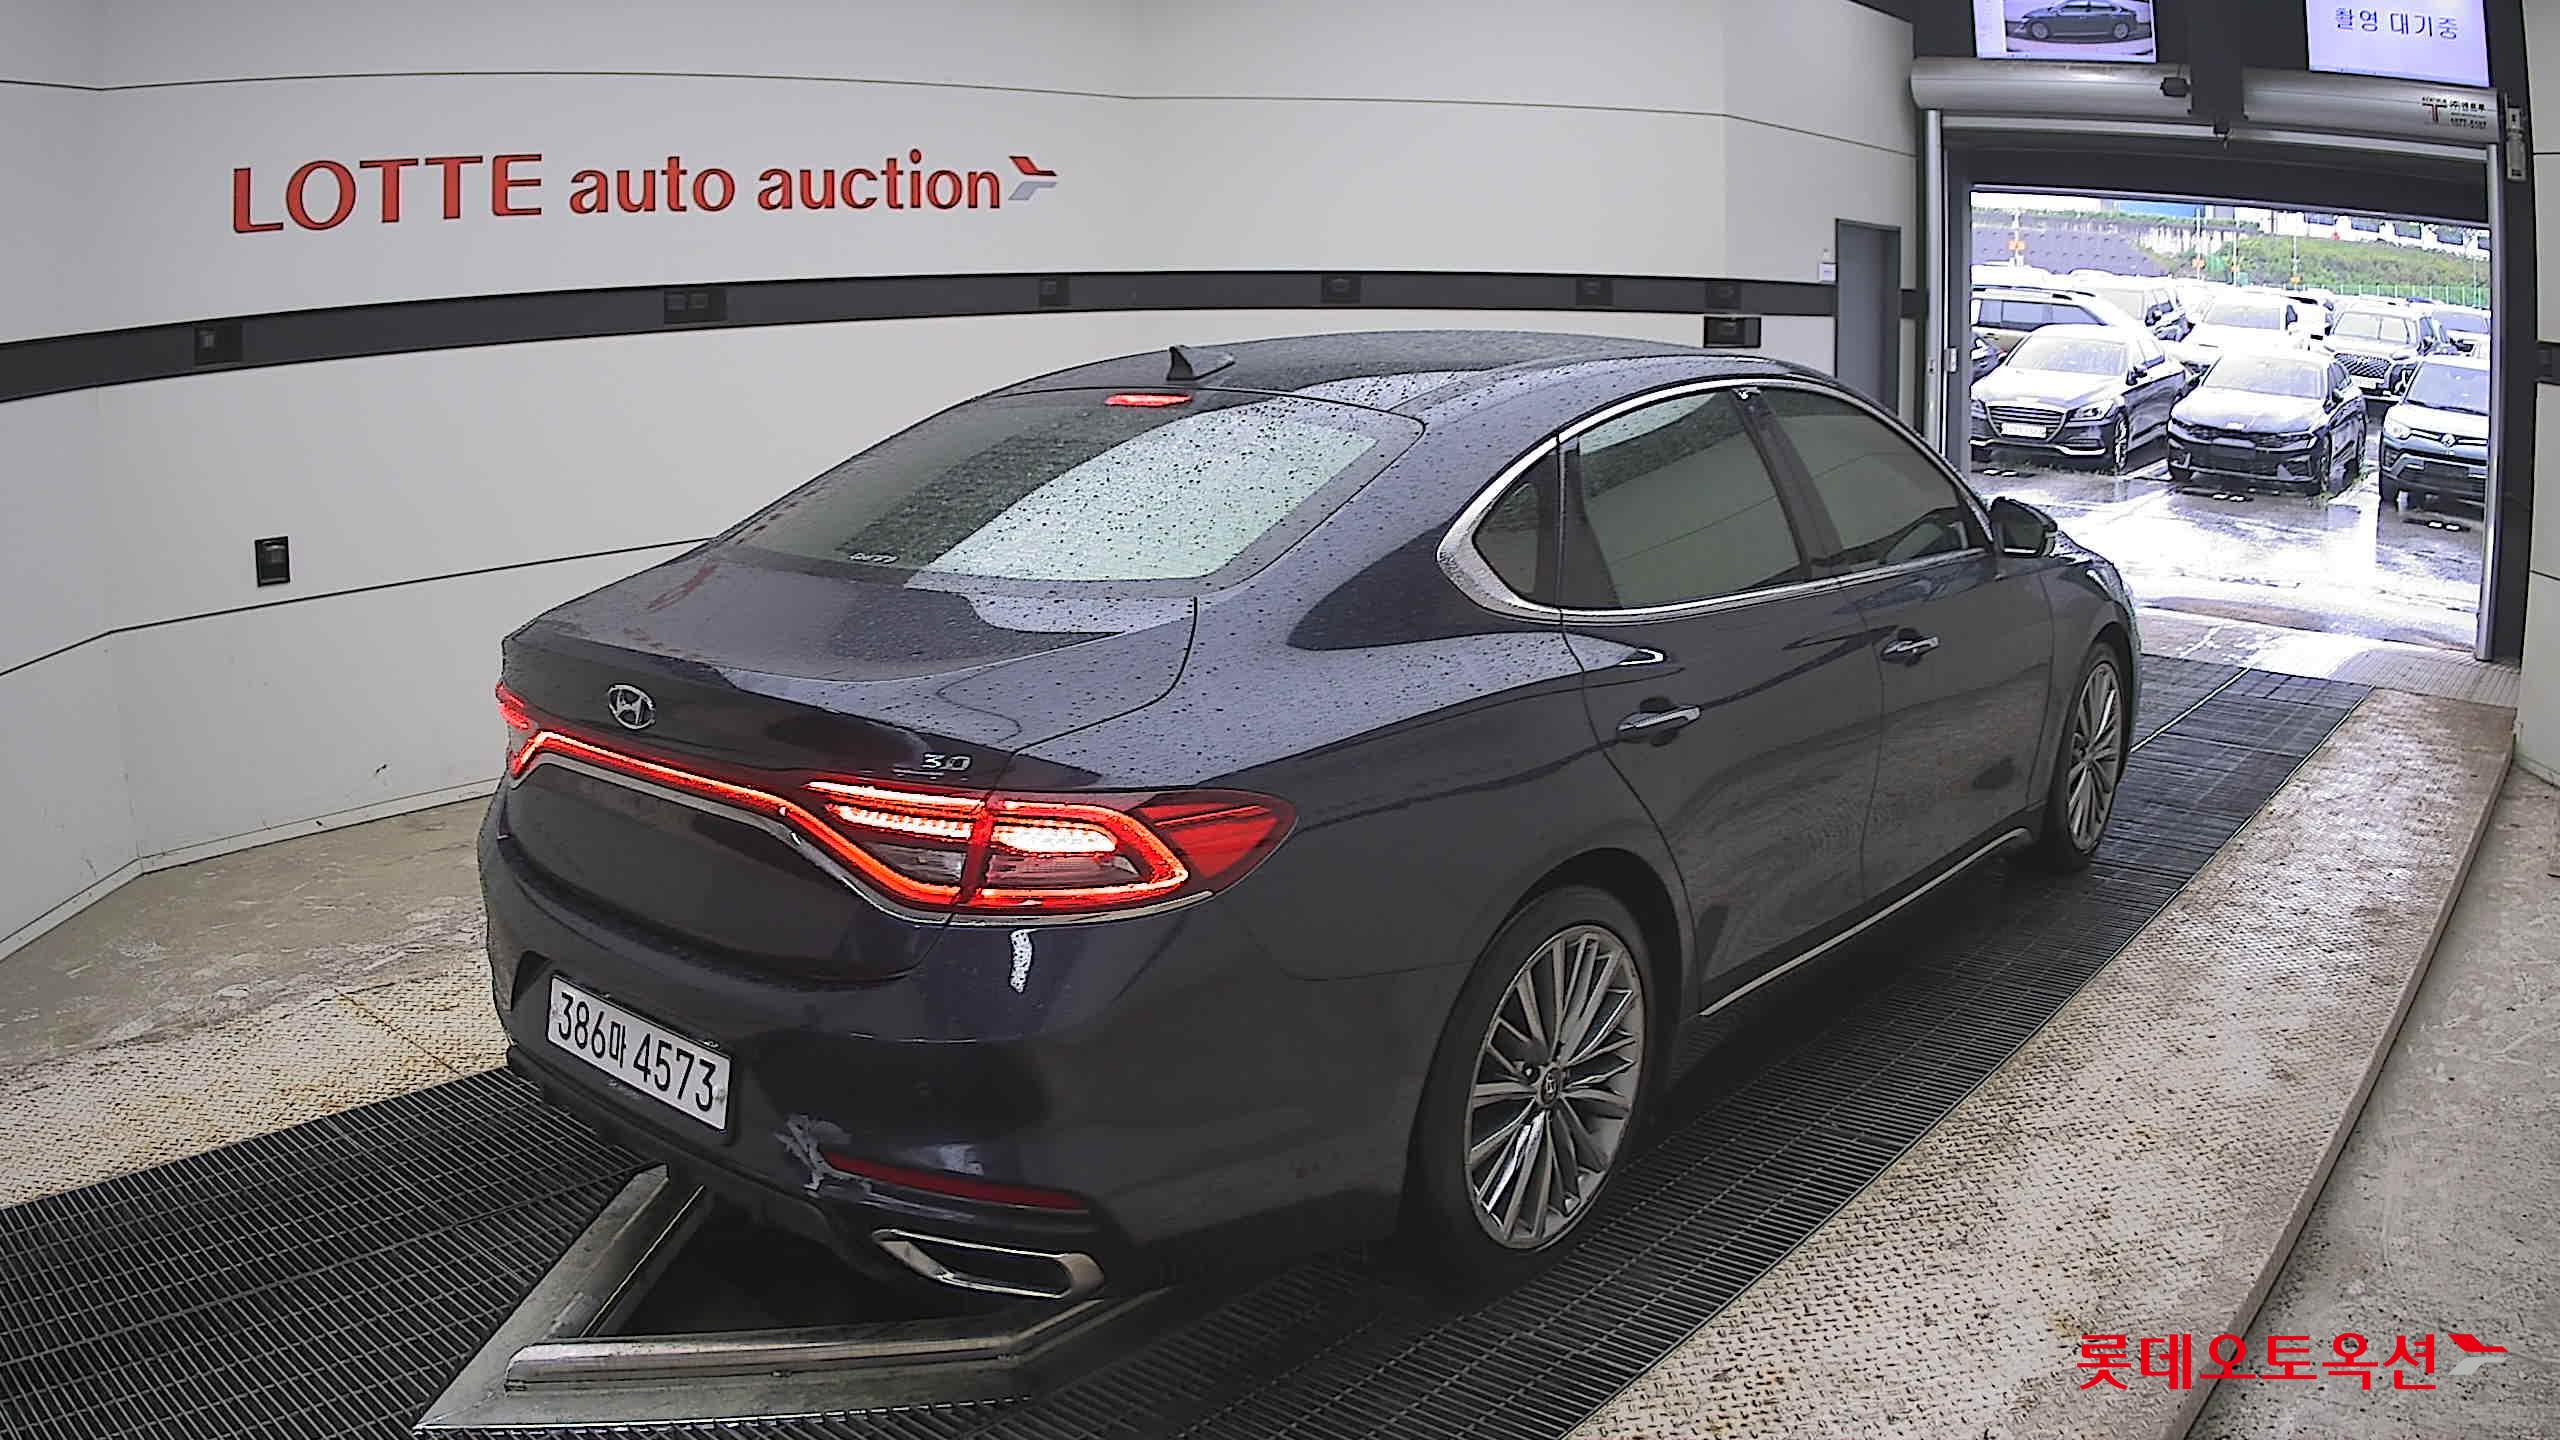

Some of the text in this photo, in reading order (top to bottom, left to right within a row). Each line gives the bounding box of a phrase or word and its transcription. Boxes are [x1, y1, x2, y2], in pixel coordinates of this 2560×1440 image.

[2389, 12, 2458, 40] 대기중
[232, 148, 1001, 235] LOTTE auto auction
[557, 991, 717, 1113] 386마 4573
